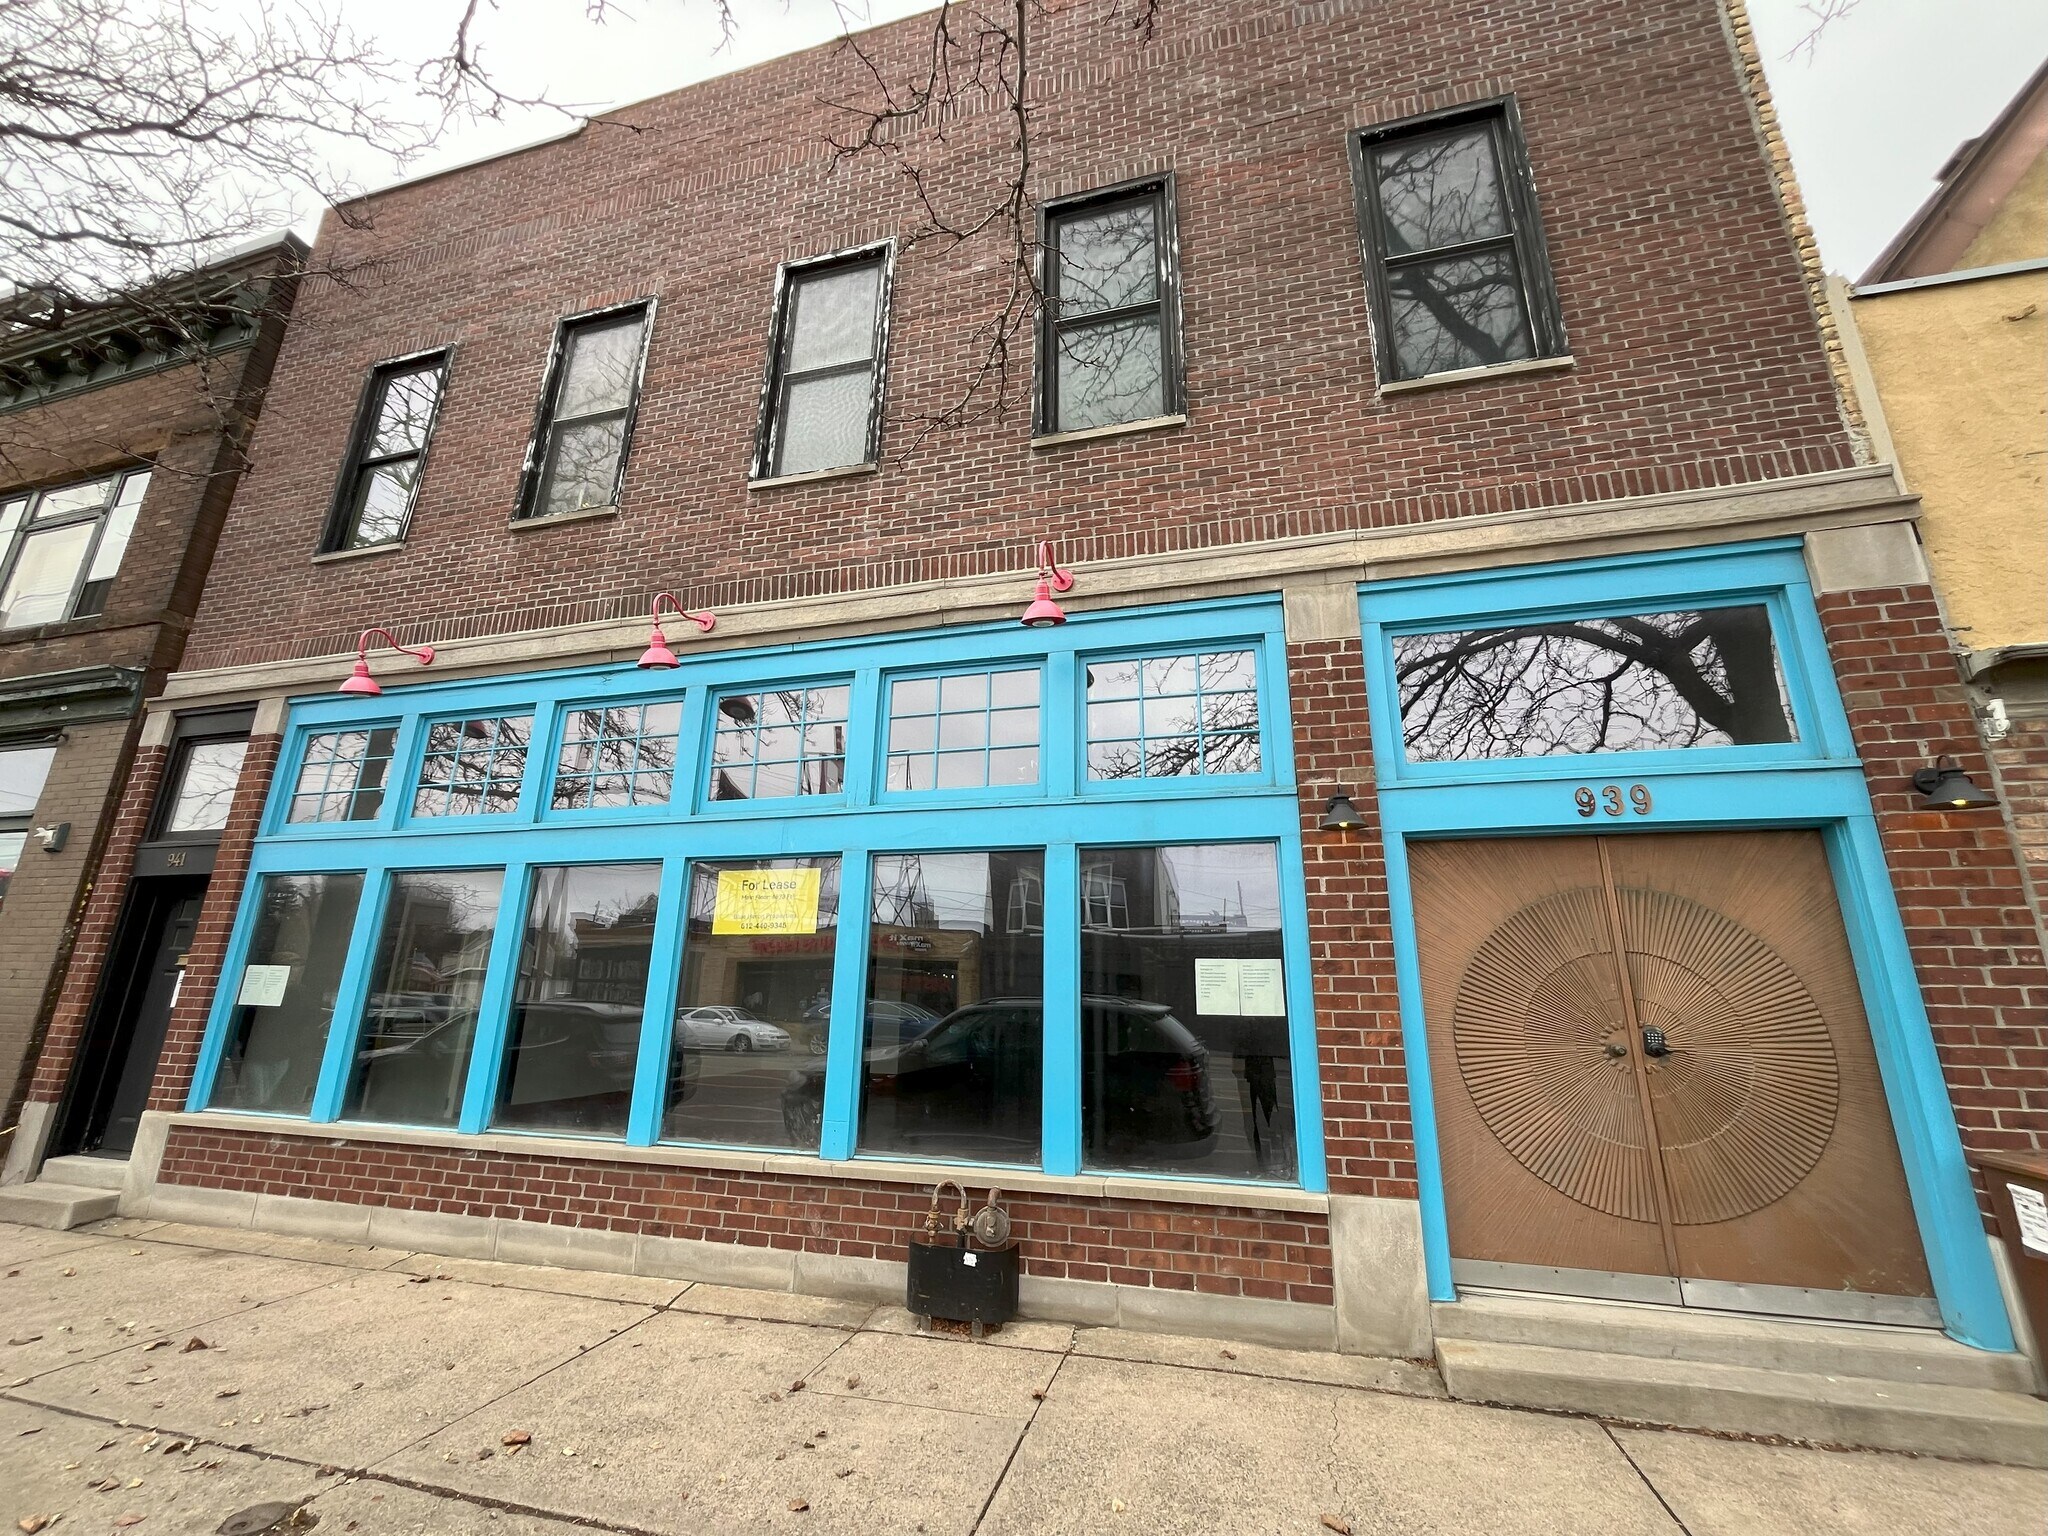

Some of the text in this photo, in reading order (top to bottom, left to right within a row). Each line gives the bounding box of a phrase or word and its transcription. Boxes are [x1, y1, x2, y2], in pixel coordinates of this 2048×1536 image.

[1574, 783, 1651, 818] 939
[167, 851, 187, 868] 941
[742, 879, 797, 891] For Lease
